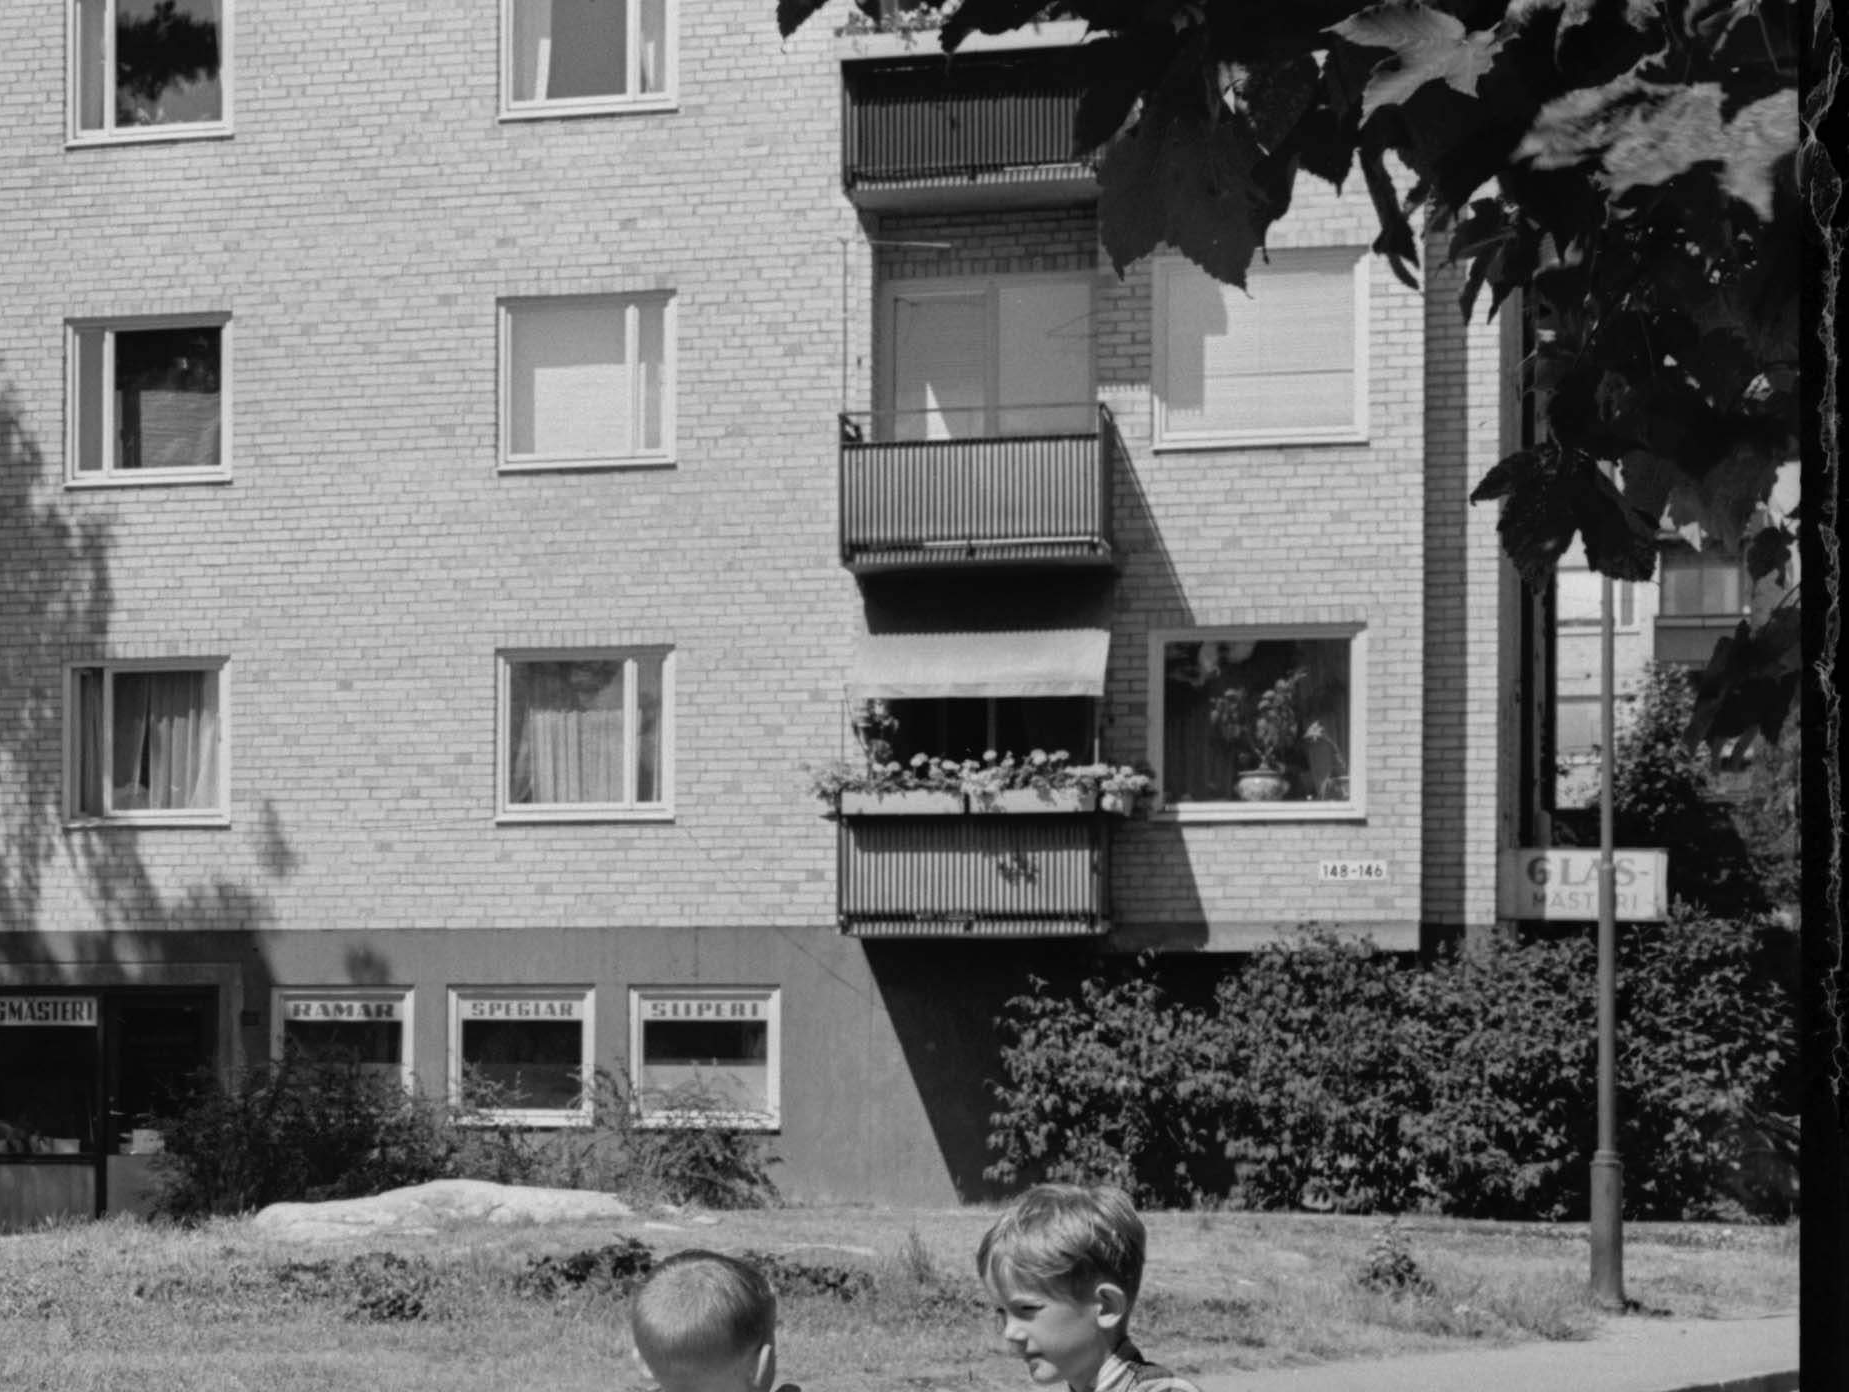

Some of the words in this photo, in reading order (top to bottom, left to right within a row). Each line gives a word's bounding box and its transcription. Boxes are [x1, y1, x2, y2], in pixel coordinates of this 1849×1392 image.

[1323, 863, 1383, 878] 148-146
[1531, 889, 1638, 910] MÄSTRI
[292, 1003, 394, 1018] RAMAR
[471, 1002, 574, 1017] SPEGLAR
